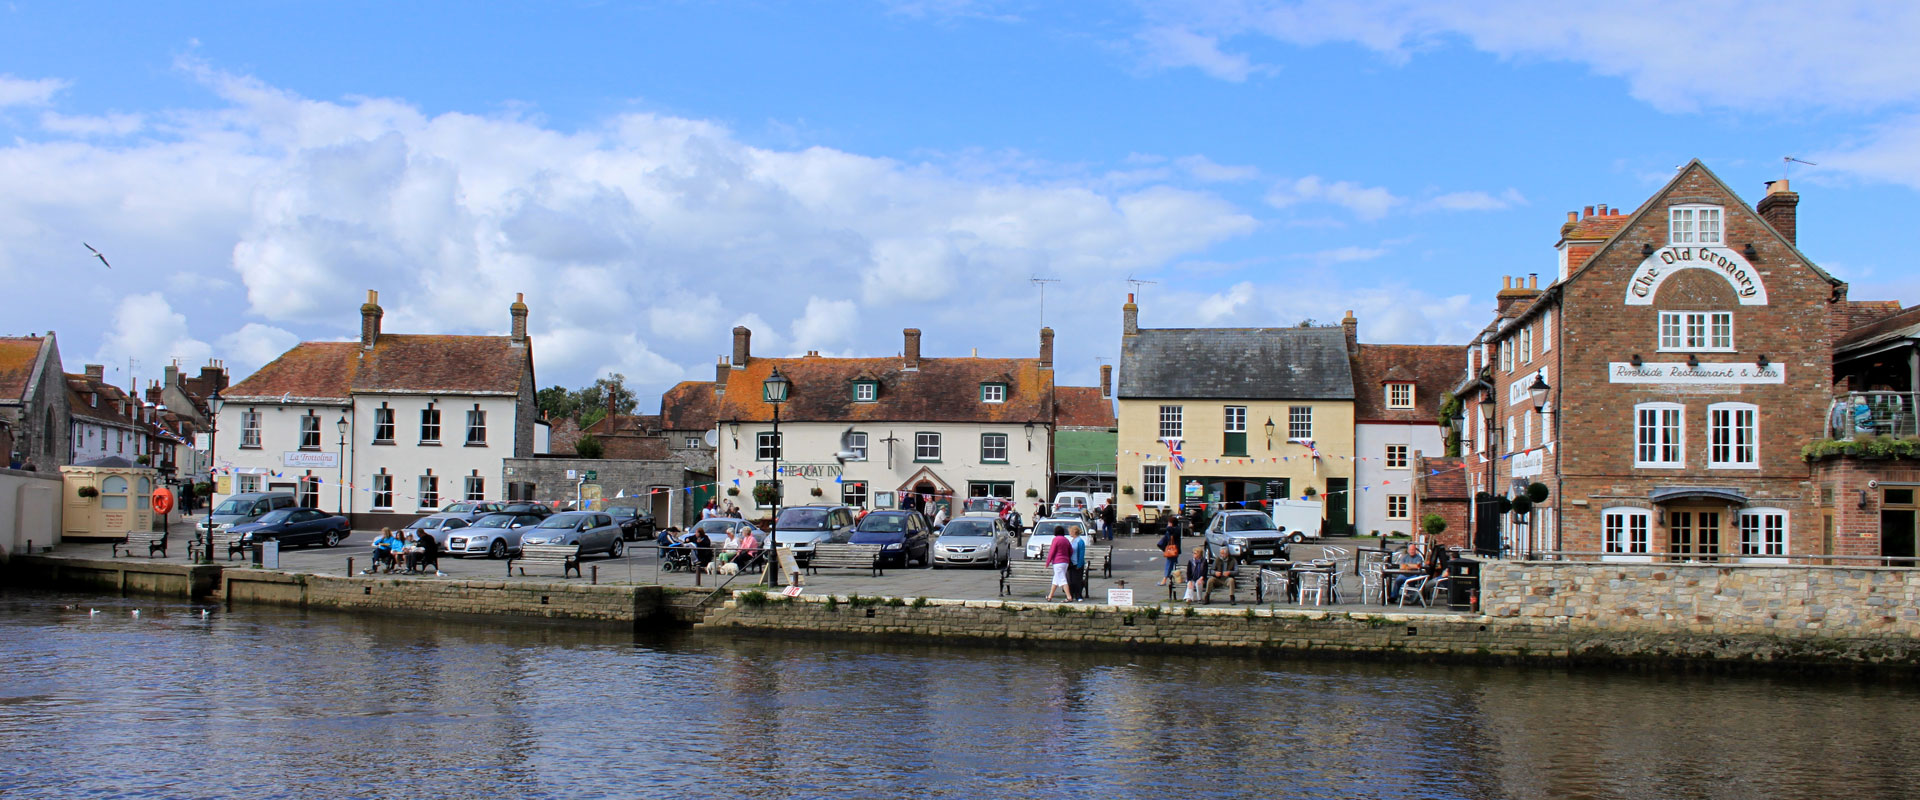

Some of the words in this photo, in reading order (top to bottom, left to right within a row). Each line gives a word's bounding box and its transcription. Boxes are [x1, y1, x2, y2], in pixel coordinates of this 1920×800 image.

[1632, 268, 1659, 298] The
[1660, 246, 1692, 265] Old
[1699, 246, 1757, 299] Granary
[1616, 365, 1663, 378] Riverside
[1669, 366, 1734, 378] Restaurant
[1740, 368, 1748, 378] &
[1752, 366, 1778, 378] Bar
[300, 453, 333, 462] Trottolina
[779, 465, 798, 477] THE
[800, 465, 824, 480] QUAY
[827, 465, 844, 477] INN
